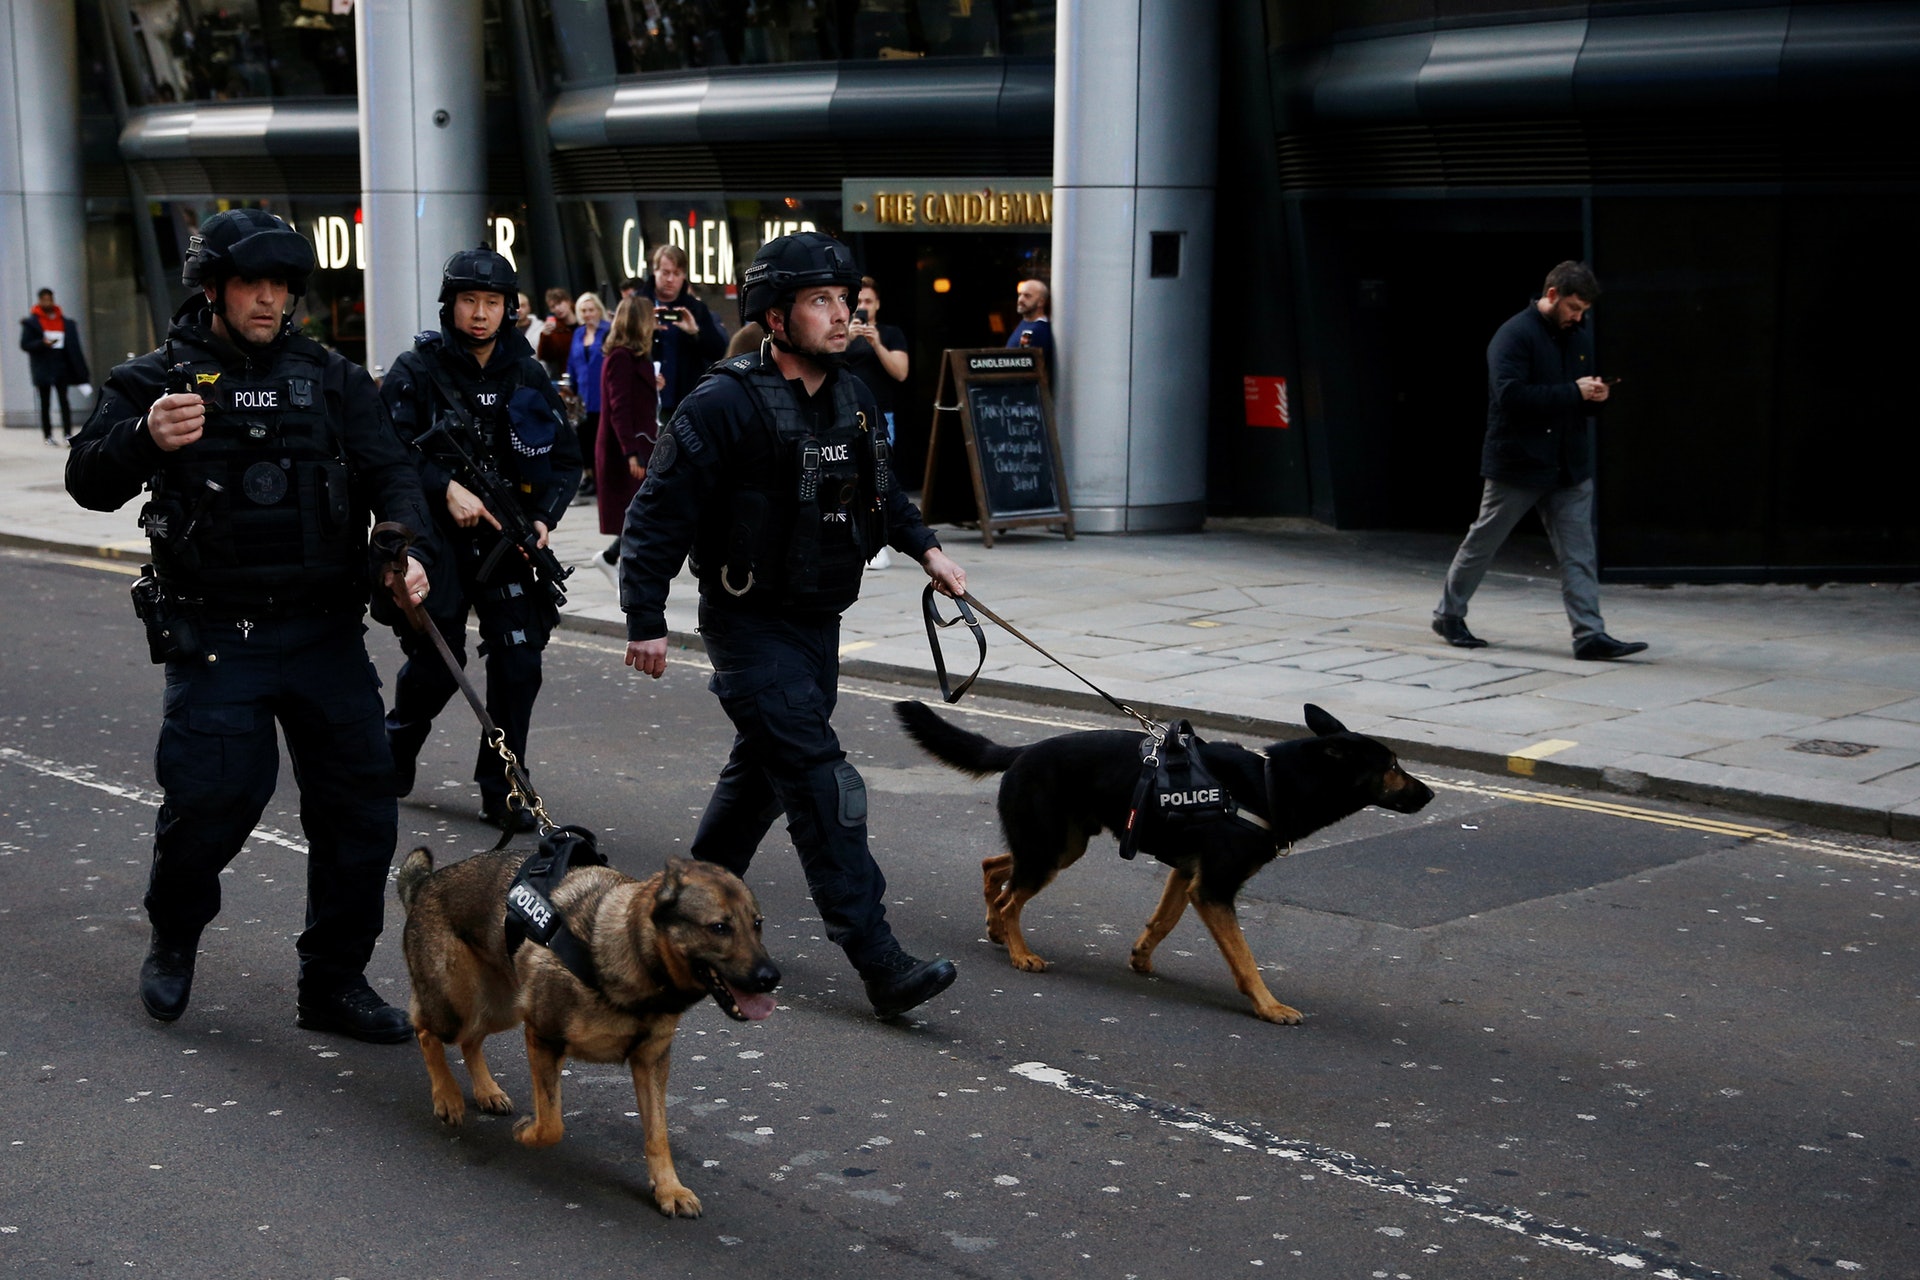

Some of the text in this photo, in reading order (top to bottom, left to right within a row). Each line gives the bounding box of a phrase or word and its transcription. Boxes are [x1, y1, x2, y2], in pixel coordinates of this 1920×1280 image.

[875, 190, 1053, 225] THE CANDLEMA
[970, 357, 1033, 369] CANDLEMAKER
[235, 391, 278, 408] POLICE
[1160, 788, 1220, 807] POLICE
[509, 884, 552, 929] POLICE
